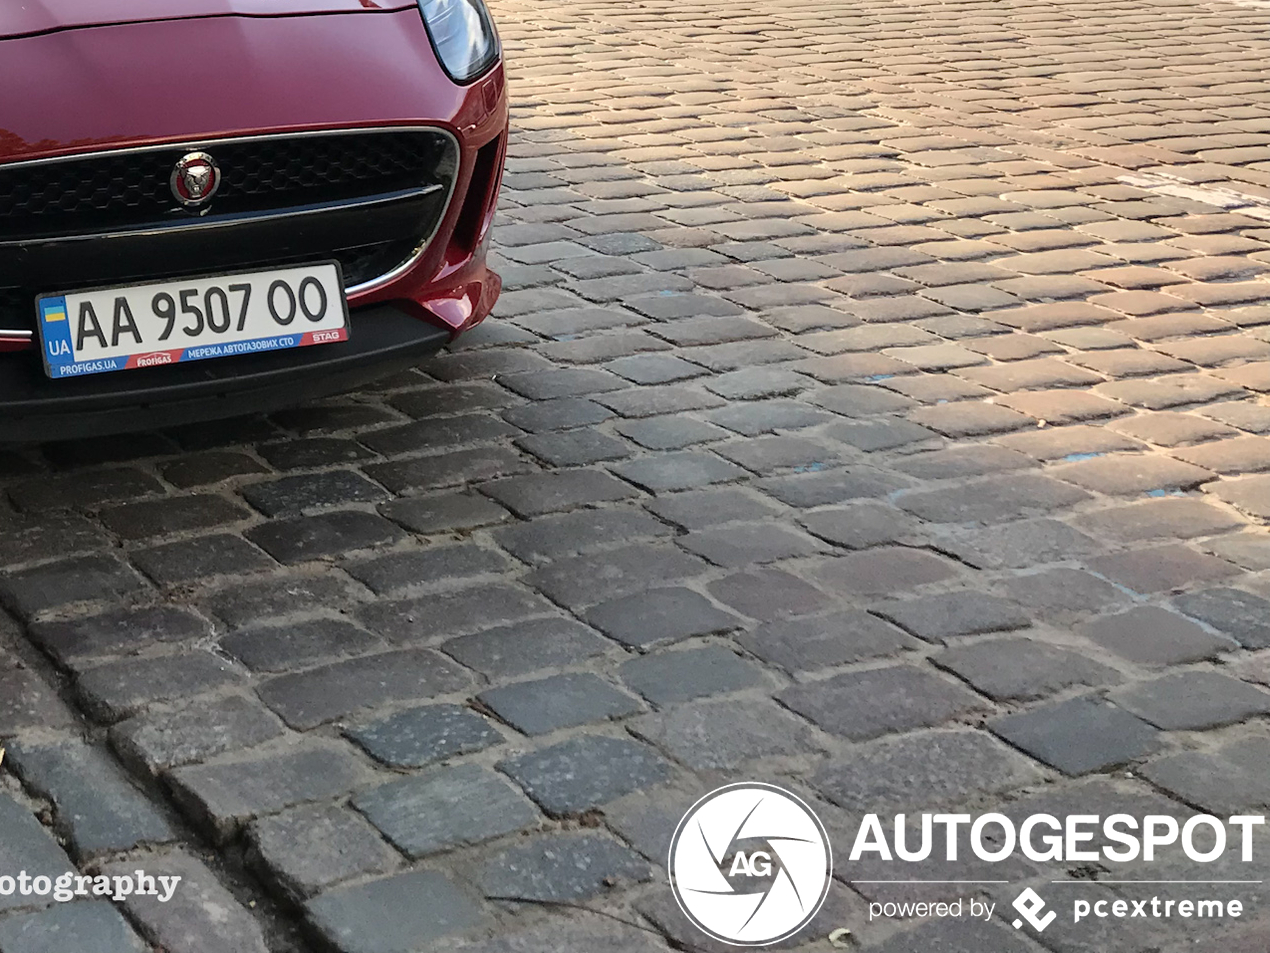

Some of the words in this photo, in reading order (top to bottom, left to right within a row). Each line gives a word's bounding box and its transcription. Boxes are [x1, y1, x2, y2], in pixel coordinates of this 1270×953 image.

[76, 296, 142, 351] AA
[151, 283, 252, 341] 9507
[312, 331, 340, 343] STAG
[49, 340, 71, 356] UA
[188, 345, 222, 359] МЕРЕЖА
[223, 339, 278, 355] АВТОГАЗОВИХ
[279, 337, 294, 347] СТО
[60, 360, 117, 375] PROFIGAS.UA
